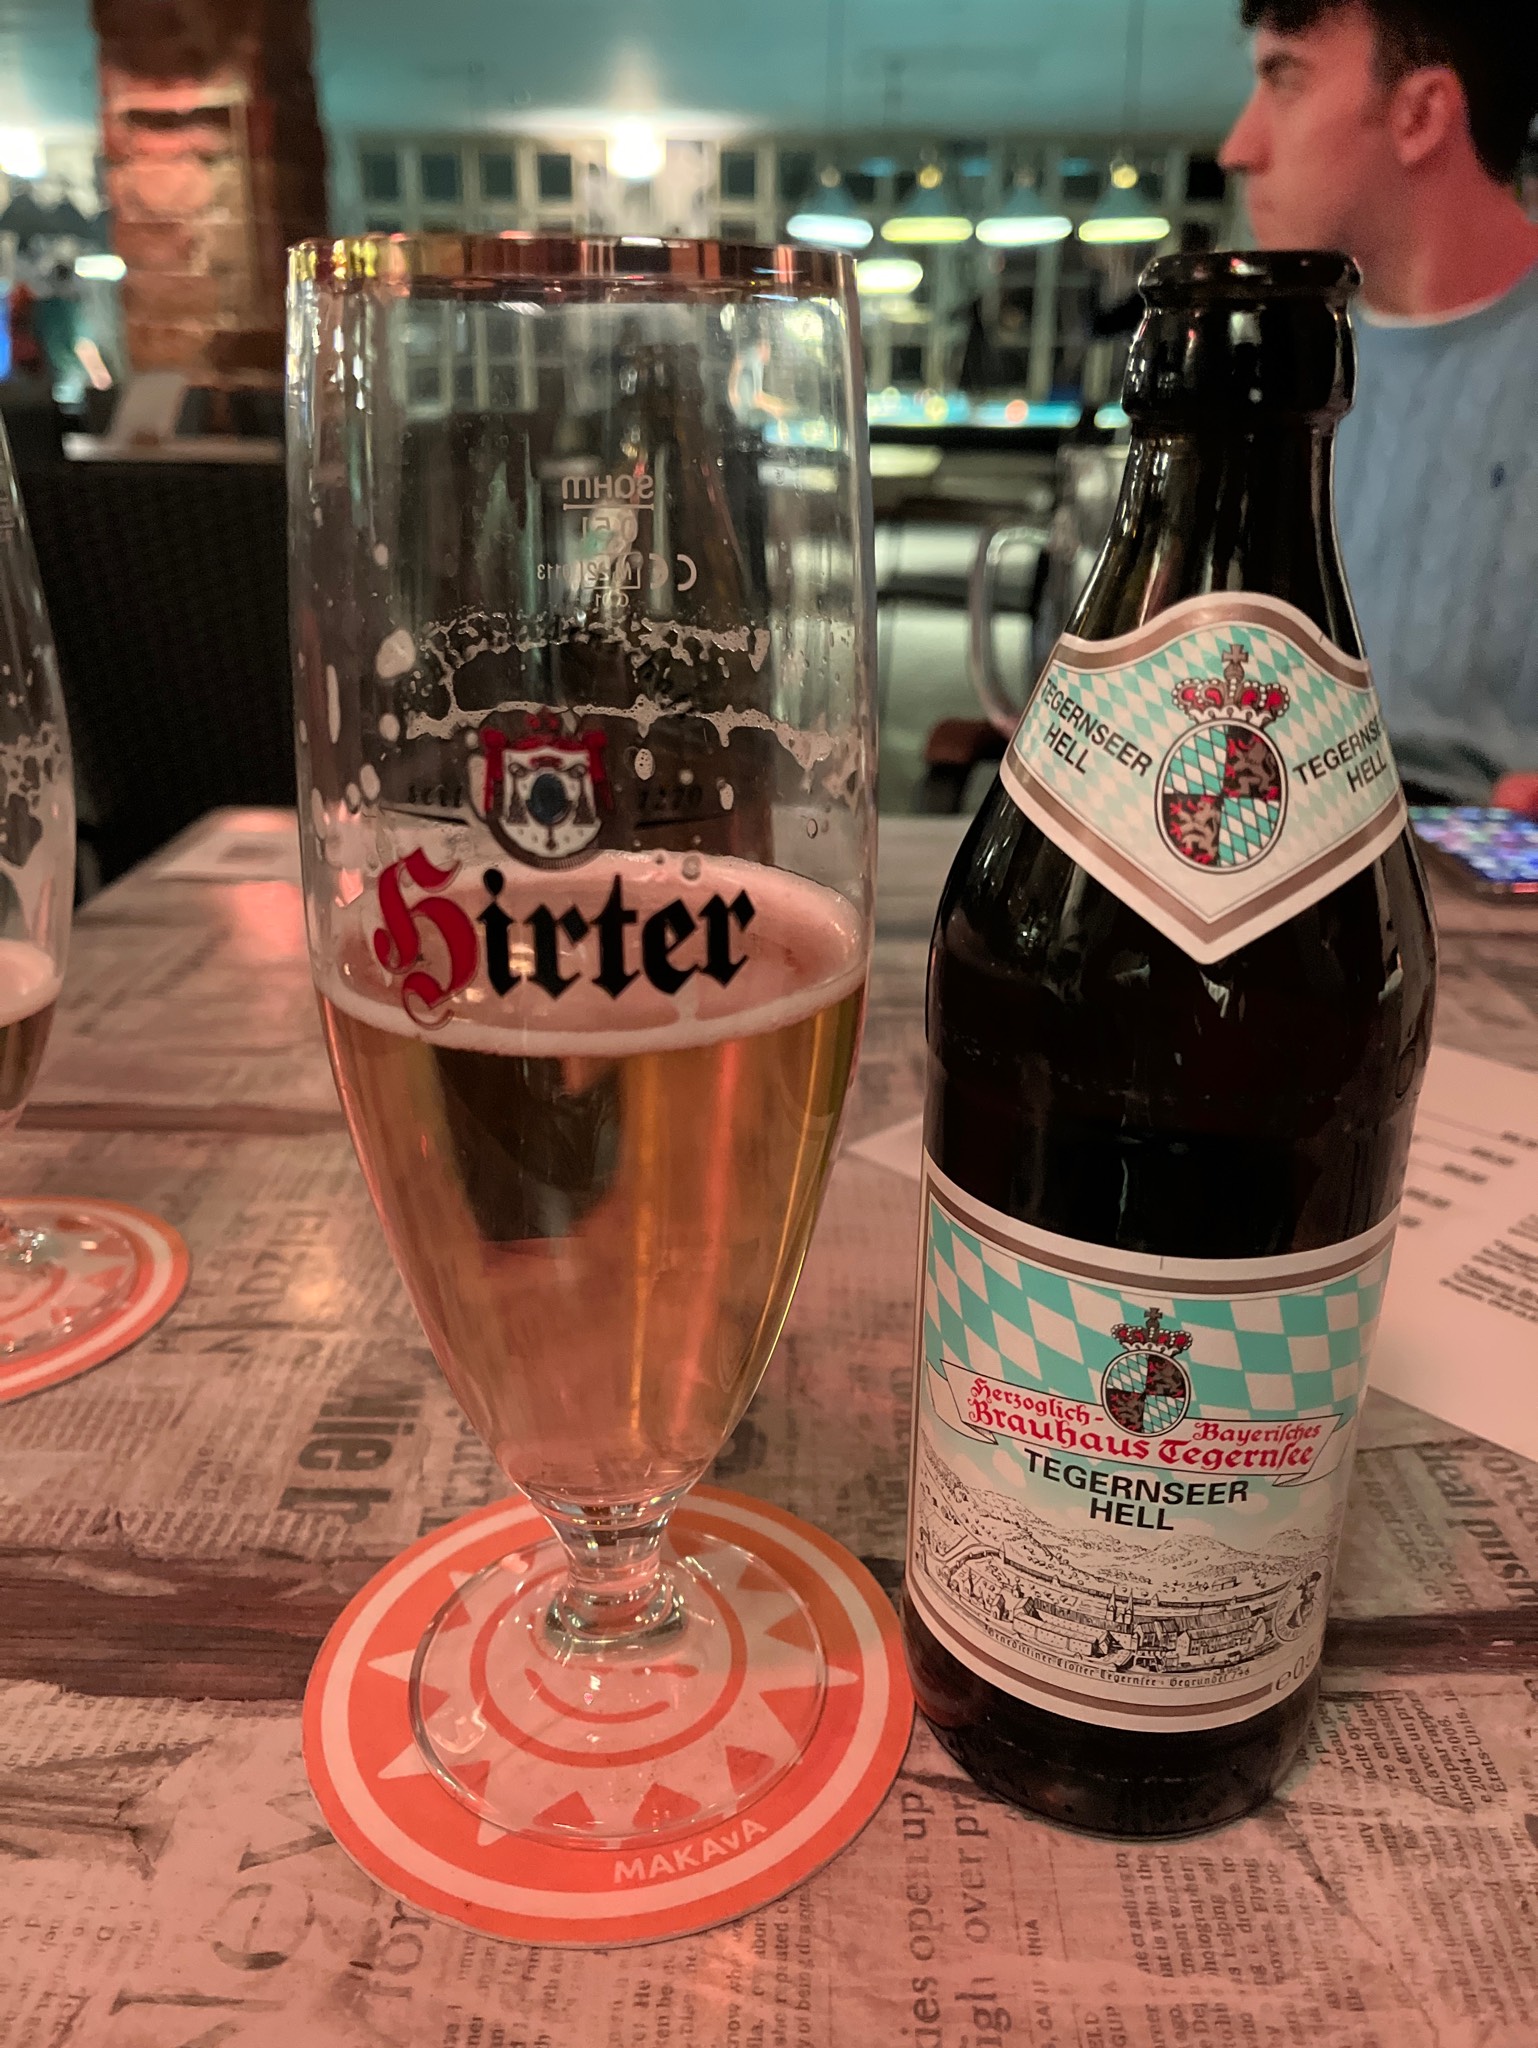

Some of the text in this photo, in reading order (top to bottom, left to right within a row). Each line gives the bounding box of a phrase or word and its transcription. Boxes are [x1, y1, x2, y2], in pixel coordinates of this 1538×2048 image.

[1041, 677, 1153, 777] TEGERNSEER
[1043, 722, 1088, 775] HELL
[1346, 750, 1387, 793] HELL
[373, 846, 757, 1030] Hirter
[969, 1397, 1150, 1460] Brauhaus
[1024, 1448, 1250, 1507] TEGERNSEER
[1089, 1497, 1175, 1532] HELL
[1434, 1746, 1462, 1773] par
[900, 1792, 935, 1842] up
[904, 1848, 951, 1961] open
[957, 1848, 991, 1944] over
